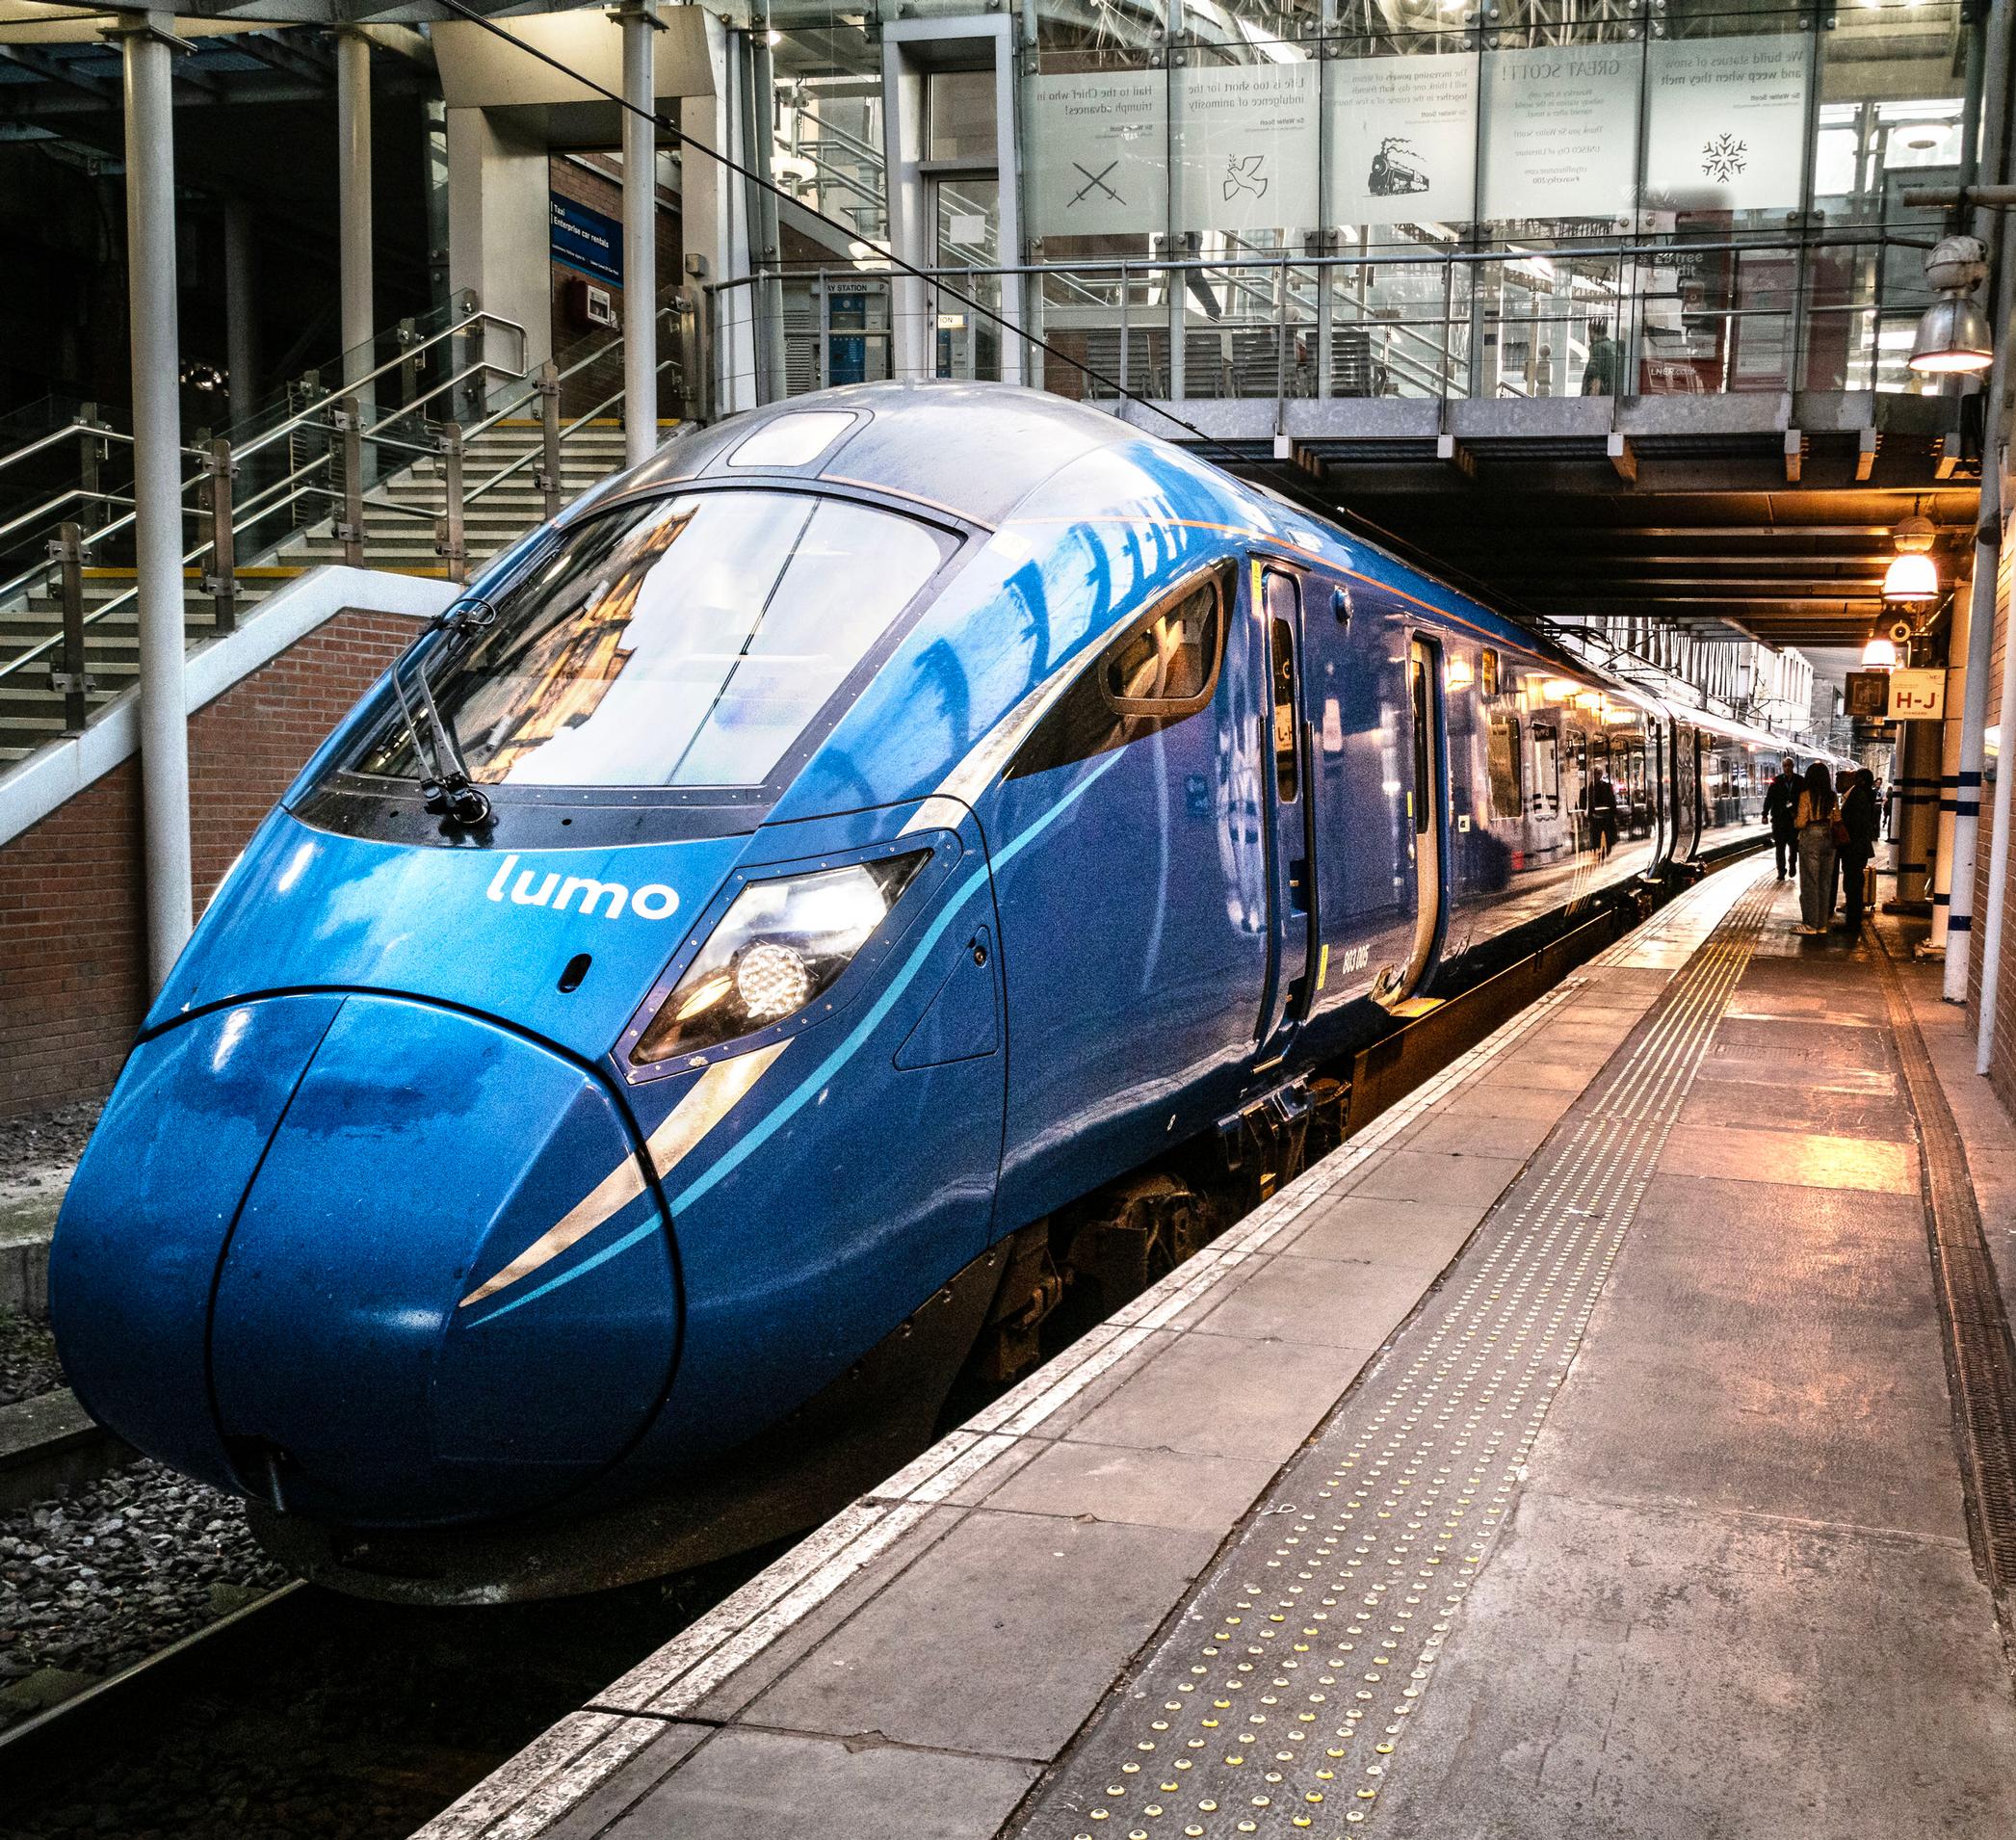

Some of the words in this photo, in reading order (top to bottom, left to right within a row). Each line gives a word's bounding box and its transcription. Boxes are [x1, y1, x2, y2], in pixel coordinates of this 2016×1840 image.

[554, 203, 565, 217] Taxi
[554, 217, 581, 235] Enterprise
[581, 229, 590, 239] car
[590, 234, 610, 248] rentals
[1675, 252, 1703, 264] free
[1897, 692, 1935, 709] H-J
[486, 854, 680, 920] lumo
